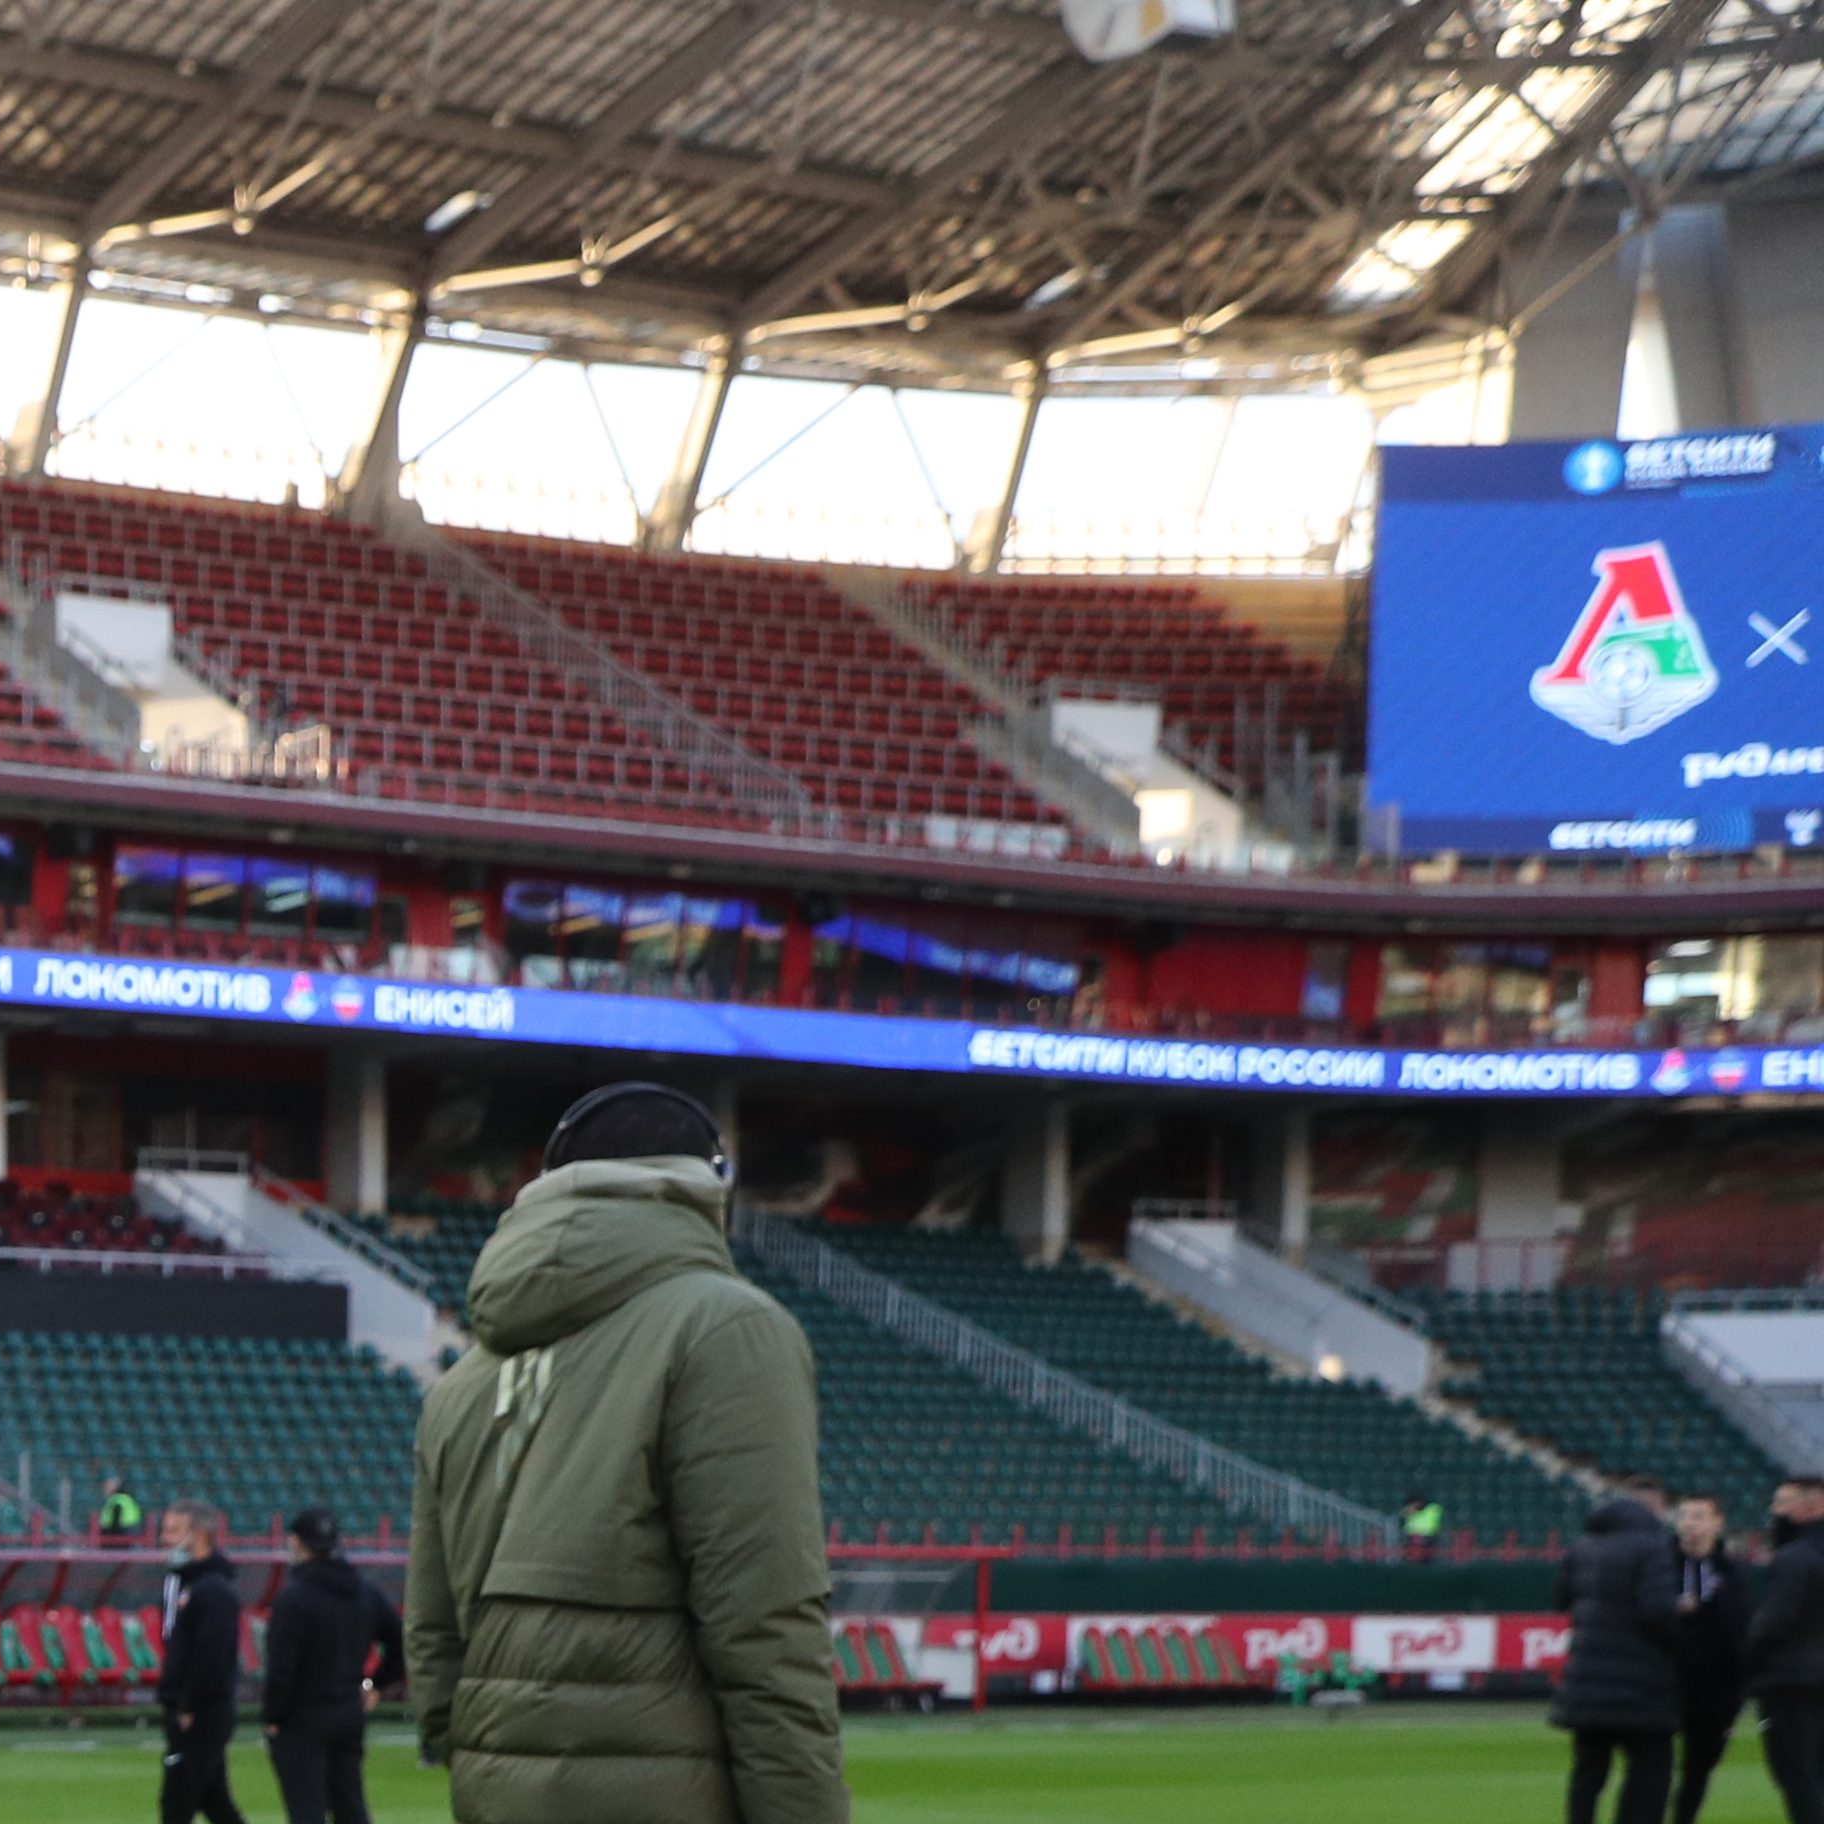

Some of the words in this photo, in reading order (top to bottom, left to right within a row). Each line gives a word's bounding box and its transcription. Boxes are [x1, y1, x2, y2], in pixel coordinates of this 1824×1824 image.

[34, 957, 272, 1014] ЛОКОМОТИВ
[374, 985, 515, 1031] ЕНИСЕЙ
[968, 1028, 1126, 1075] БЕТСИТИ
[1127, 1039, 1236, 1082] КУБОК
[1237, 1046, 1385, 1088] РОССИИ
[1397, 1051, 1641, 1091] ЛОКОМОТИВ
